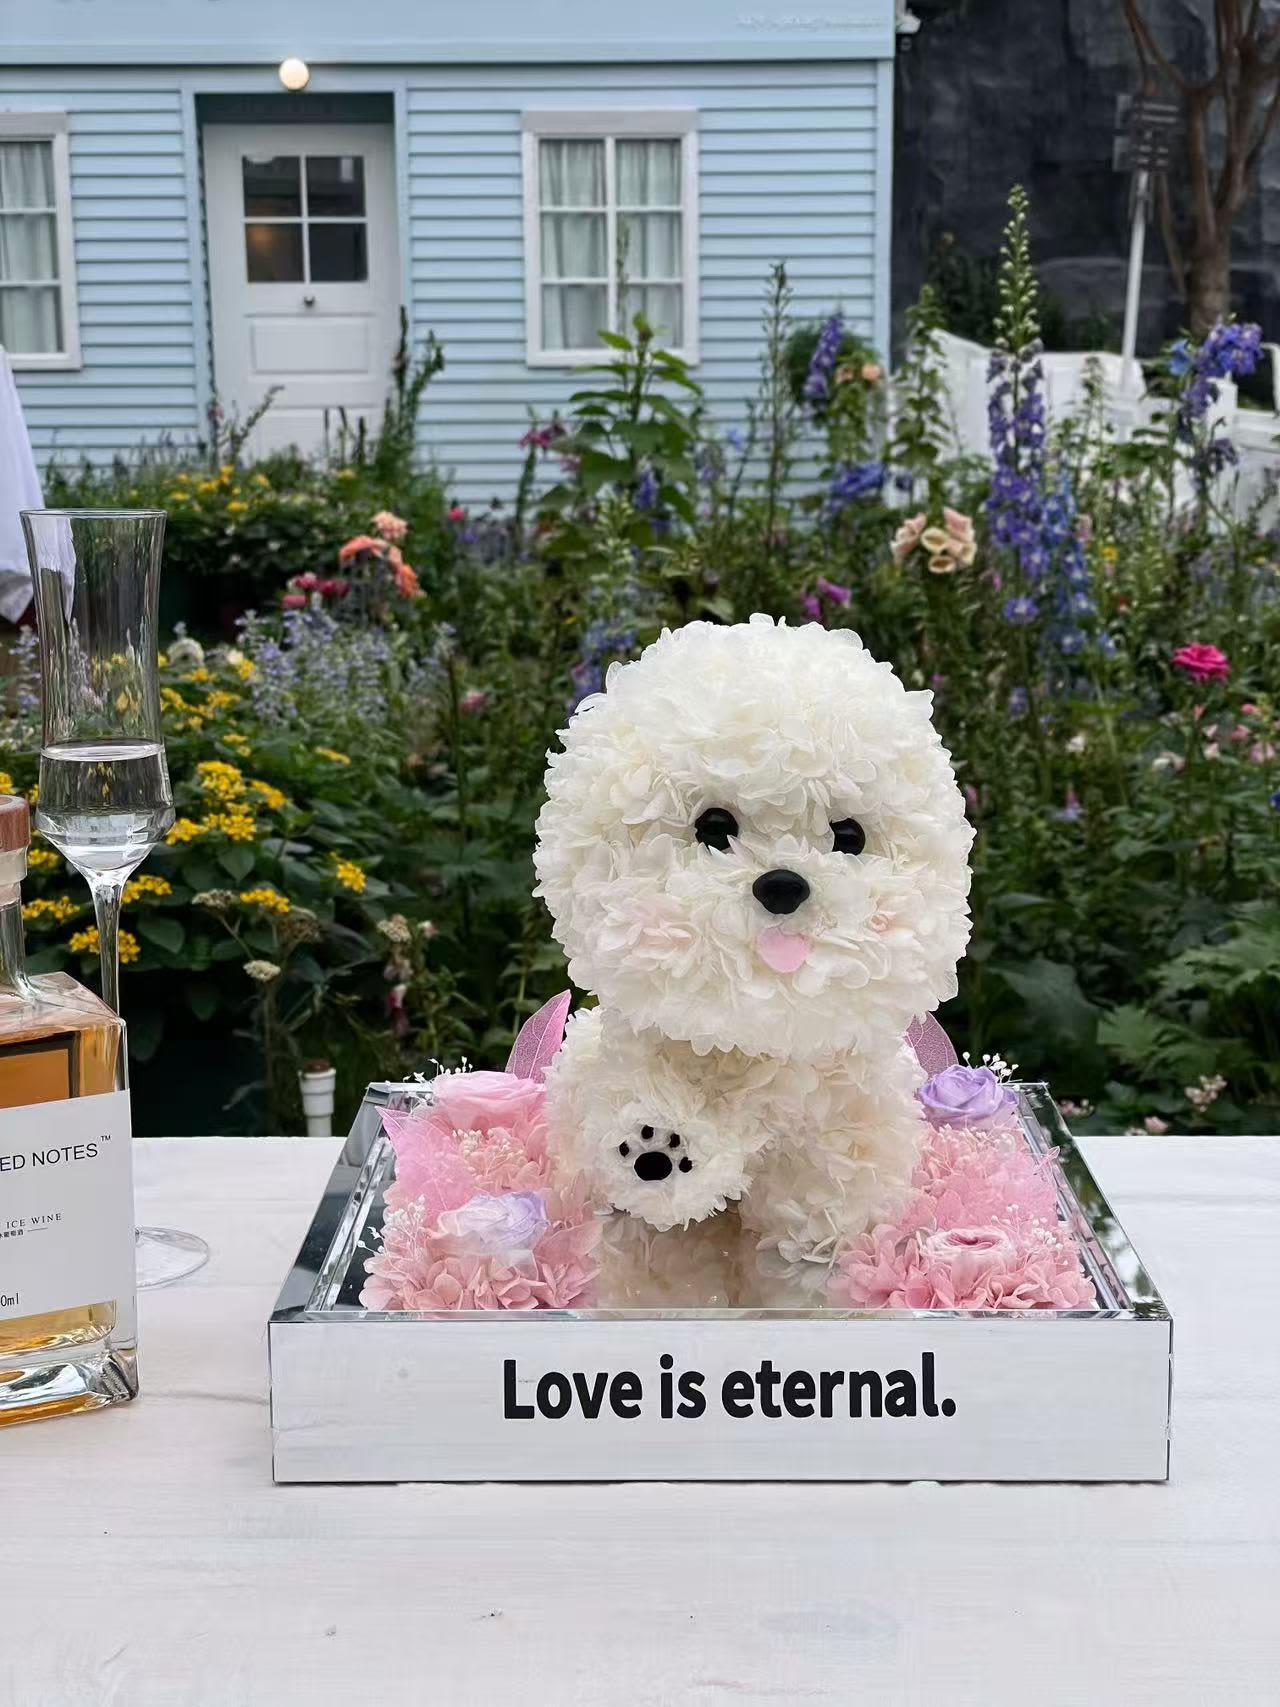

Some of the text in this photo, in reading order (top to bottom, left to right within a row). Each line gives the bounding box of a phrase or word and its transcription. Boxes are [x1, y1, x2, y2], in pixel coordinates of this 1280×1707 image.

[0, 1153, 26, 1172] ED
[33, 1142, 98, 1168] NOTES
[6, 1212, 62, 1229] ICE WINE
[503, 1351, 957, 1420] Love is eternal.
